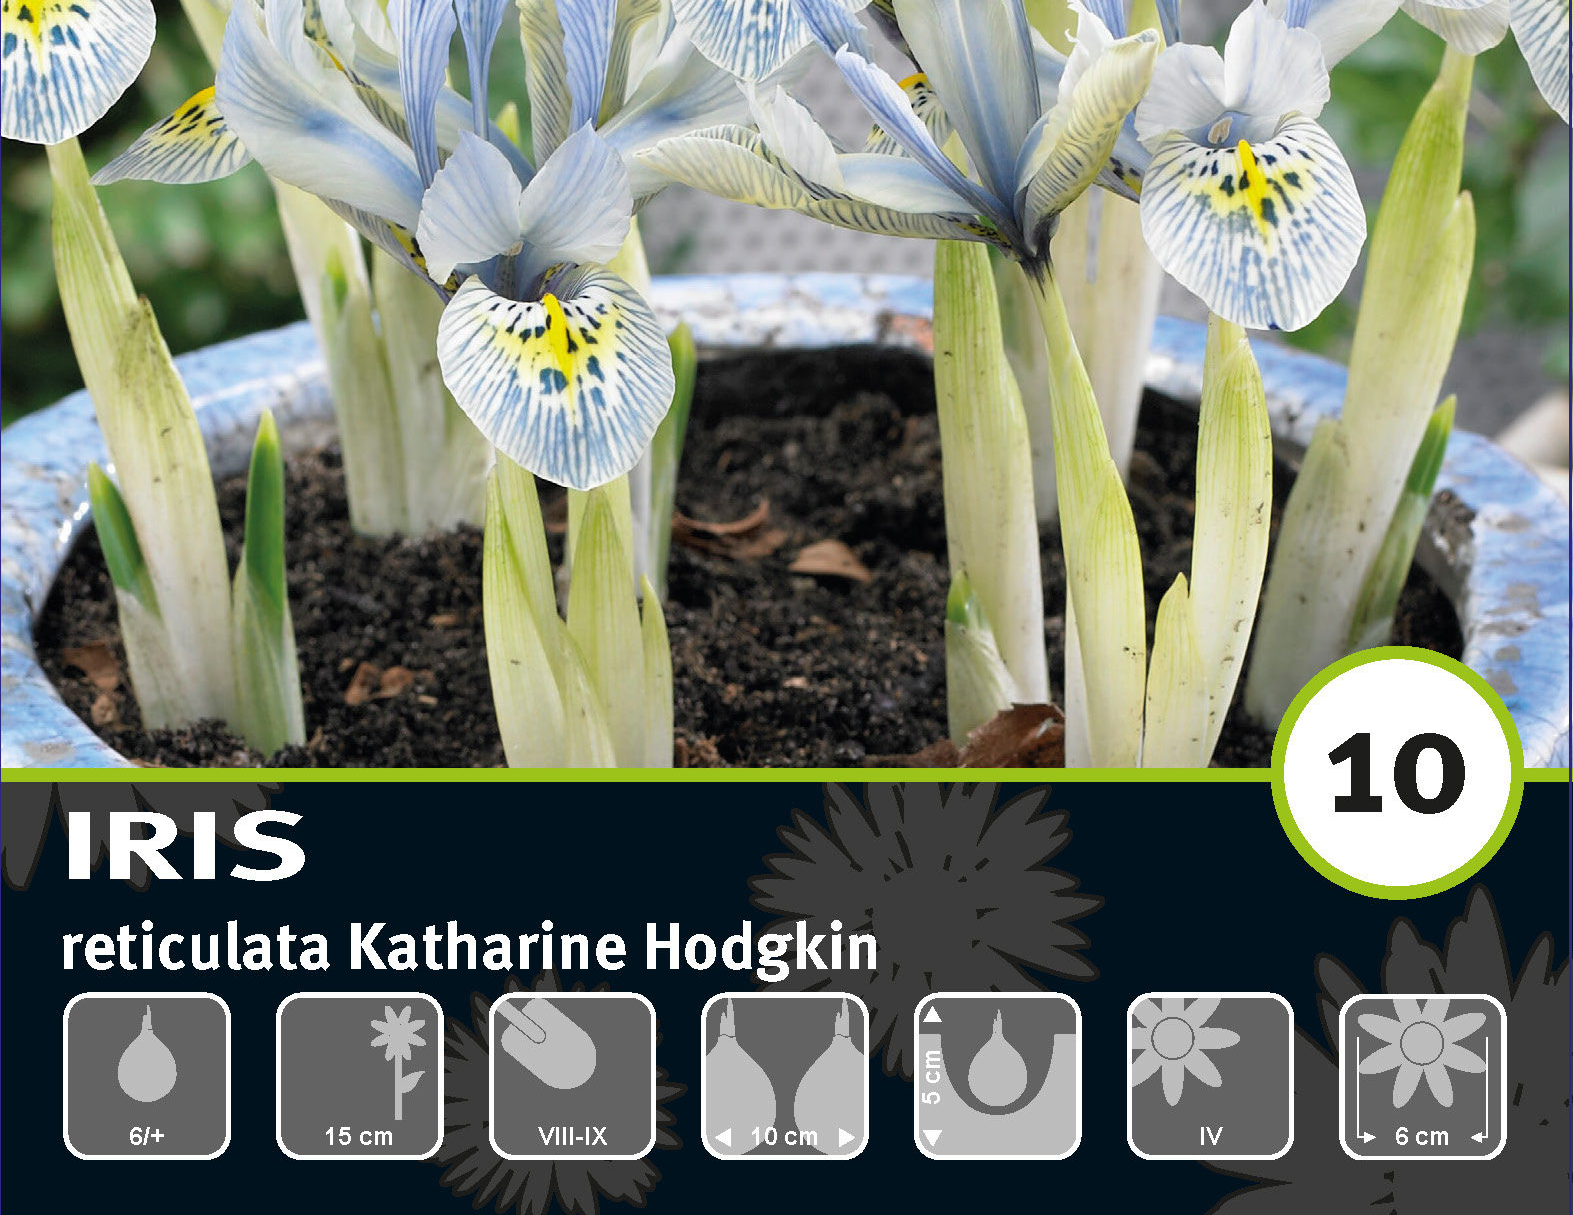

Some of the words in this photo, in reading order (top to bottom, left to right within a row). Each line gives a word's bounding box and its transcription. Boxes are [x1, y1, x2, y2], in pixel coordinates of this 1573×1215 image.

[1328, 733, 1466, 815] 10
[68, 809, 306, 882] IRIS
[62, 919, 331, 972] reticulata
[350, 919, 627, 972] Katharine
[646, 919, 877, 983] Hodgkin
[925, 1050, 941, 1084] cm
[921, 1090, 941, 1105] 5
[129, 1126, 165, 1146] 6/+
[325, 1126, 352, 1146] 15
[359, 1130, 393, 1146] cm
[537, 1126, 608, 1146] VIII-IX
[751, 1126, 778, 1146] 10
[784, 1130, 818, 1146] cm
[1200, 1126, 1224, 1146] IV
[1395, 1126, 1409, 1146] 6
[1415, 1130, 1449, 1146] cm
